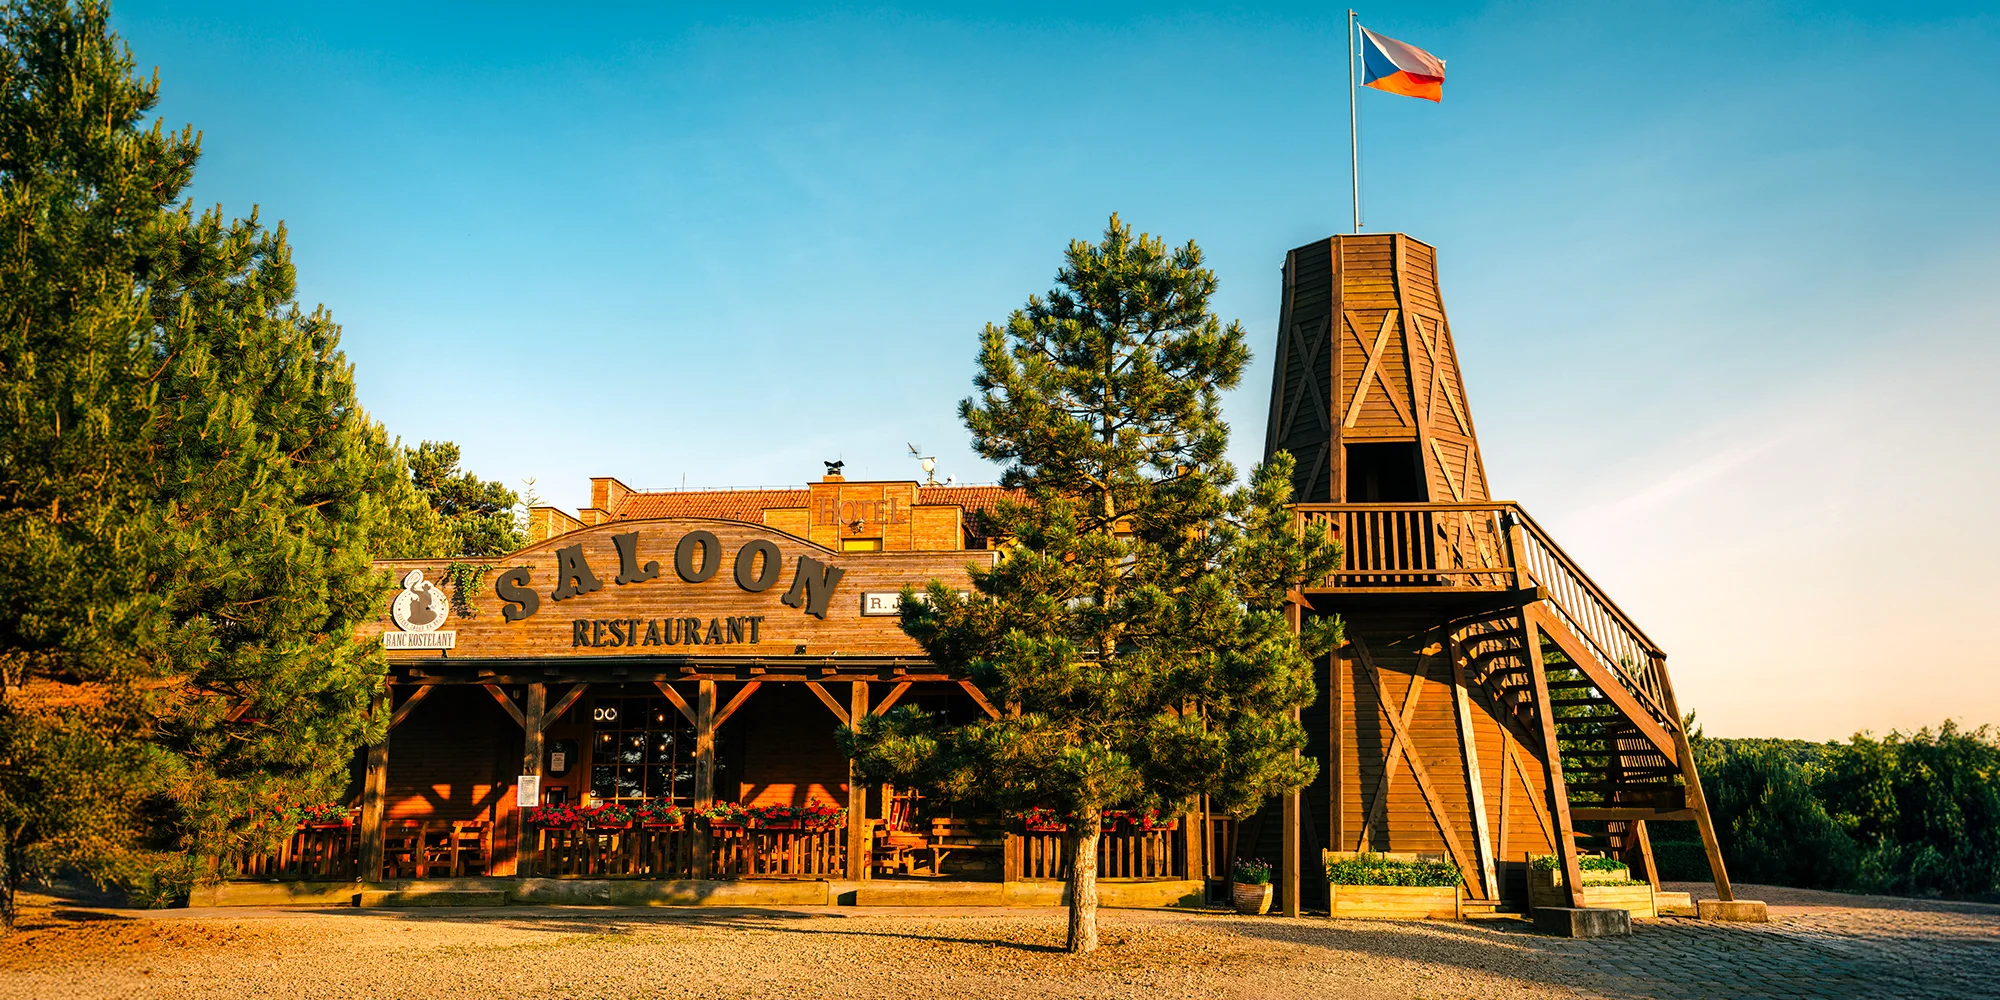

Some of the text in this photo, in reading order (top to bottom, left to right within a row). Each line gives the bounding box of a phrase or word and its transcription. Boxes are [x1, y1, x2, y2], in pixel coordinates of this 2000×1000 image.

[819, 497, 905, 526] HOTEL
[494, 529, 846, 623] SALOON
[408, 632, 453, 647] KOSTELANY
[572, 615, 765, 648] RESTAURANT
